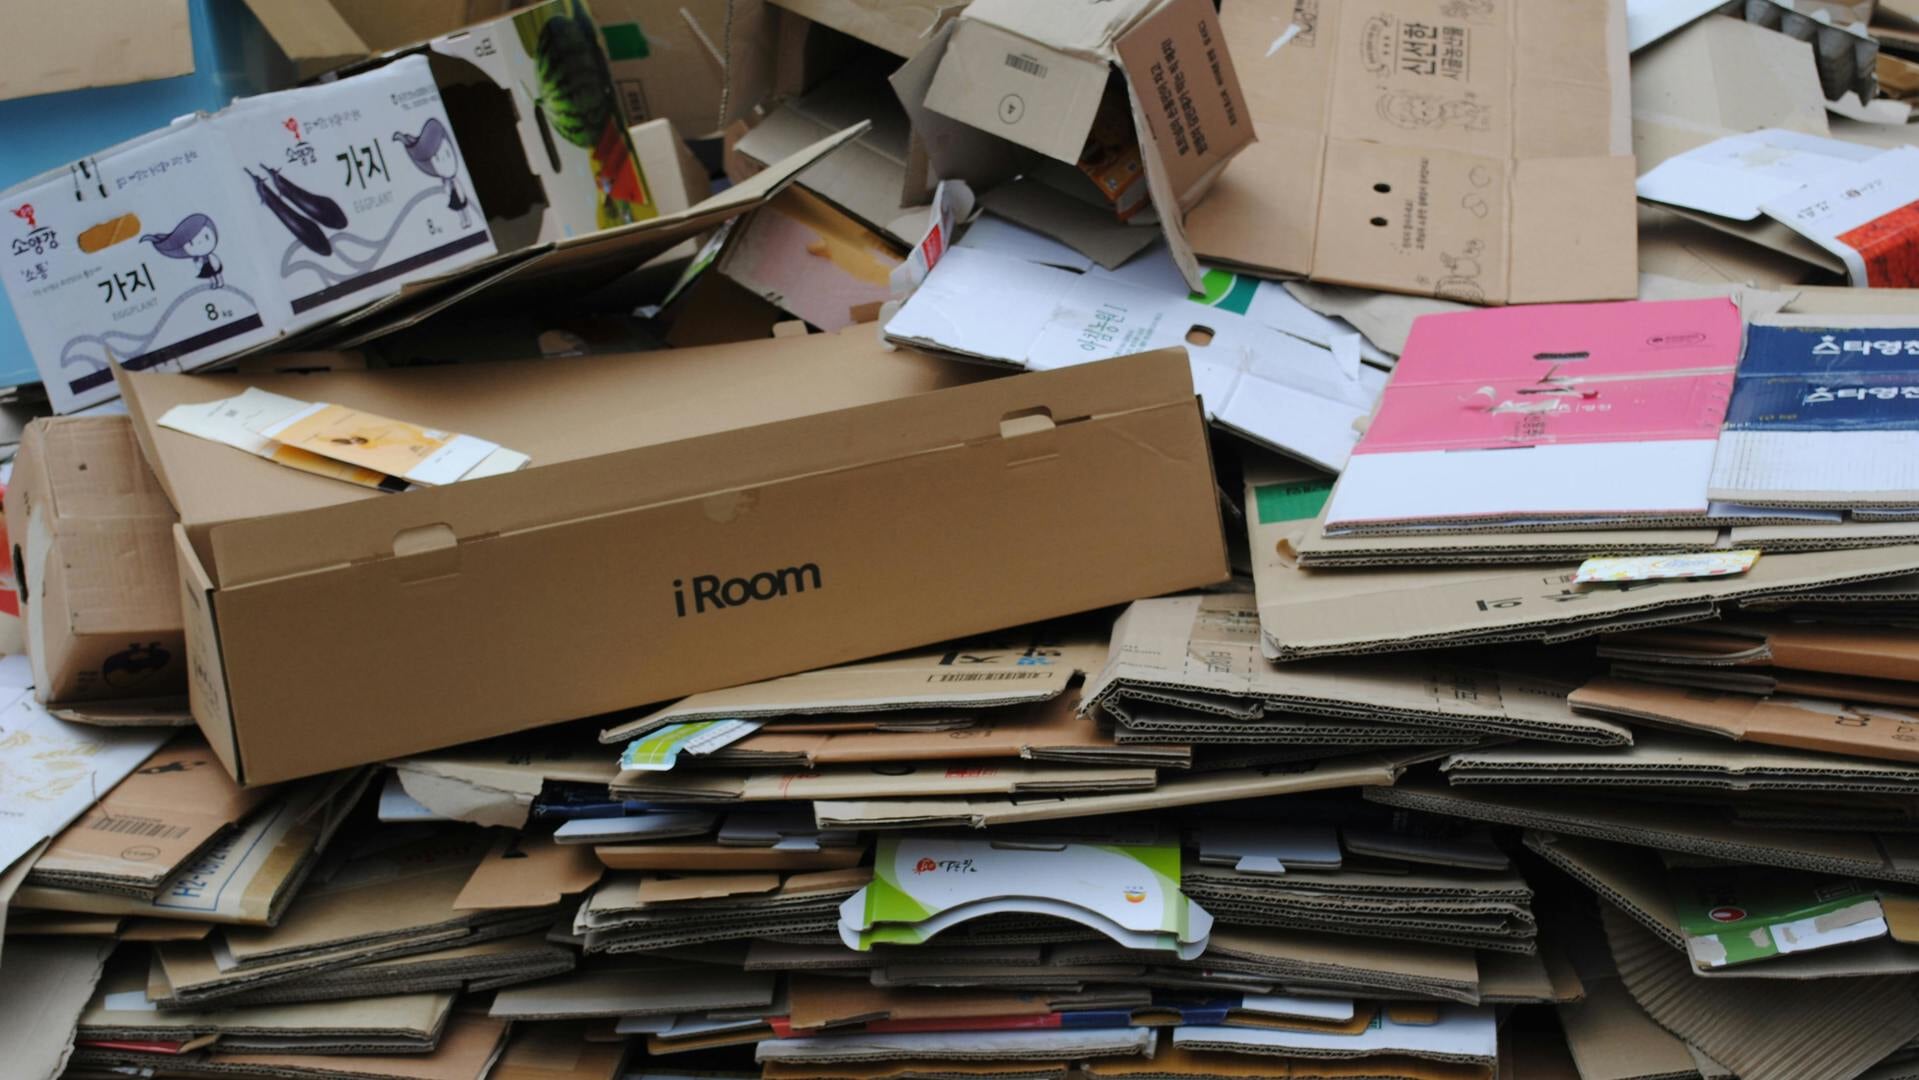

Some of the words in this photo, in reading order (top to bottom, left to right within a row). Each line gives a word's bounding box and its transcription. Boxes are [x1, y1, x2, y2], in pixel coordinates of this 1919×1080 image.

[1402, 22, 1438, 76] 신선한
[336, 139, 390, 189] 가지
[12, 229, 59, 256] 소양강
[98, 263, 155, 303] 가지
[112, 297, 158, 321] EGGPLANT
[205, 303, 219, 321] 8
